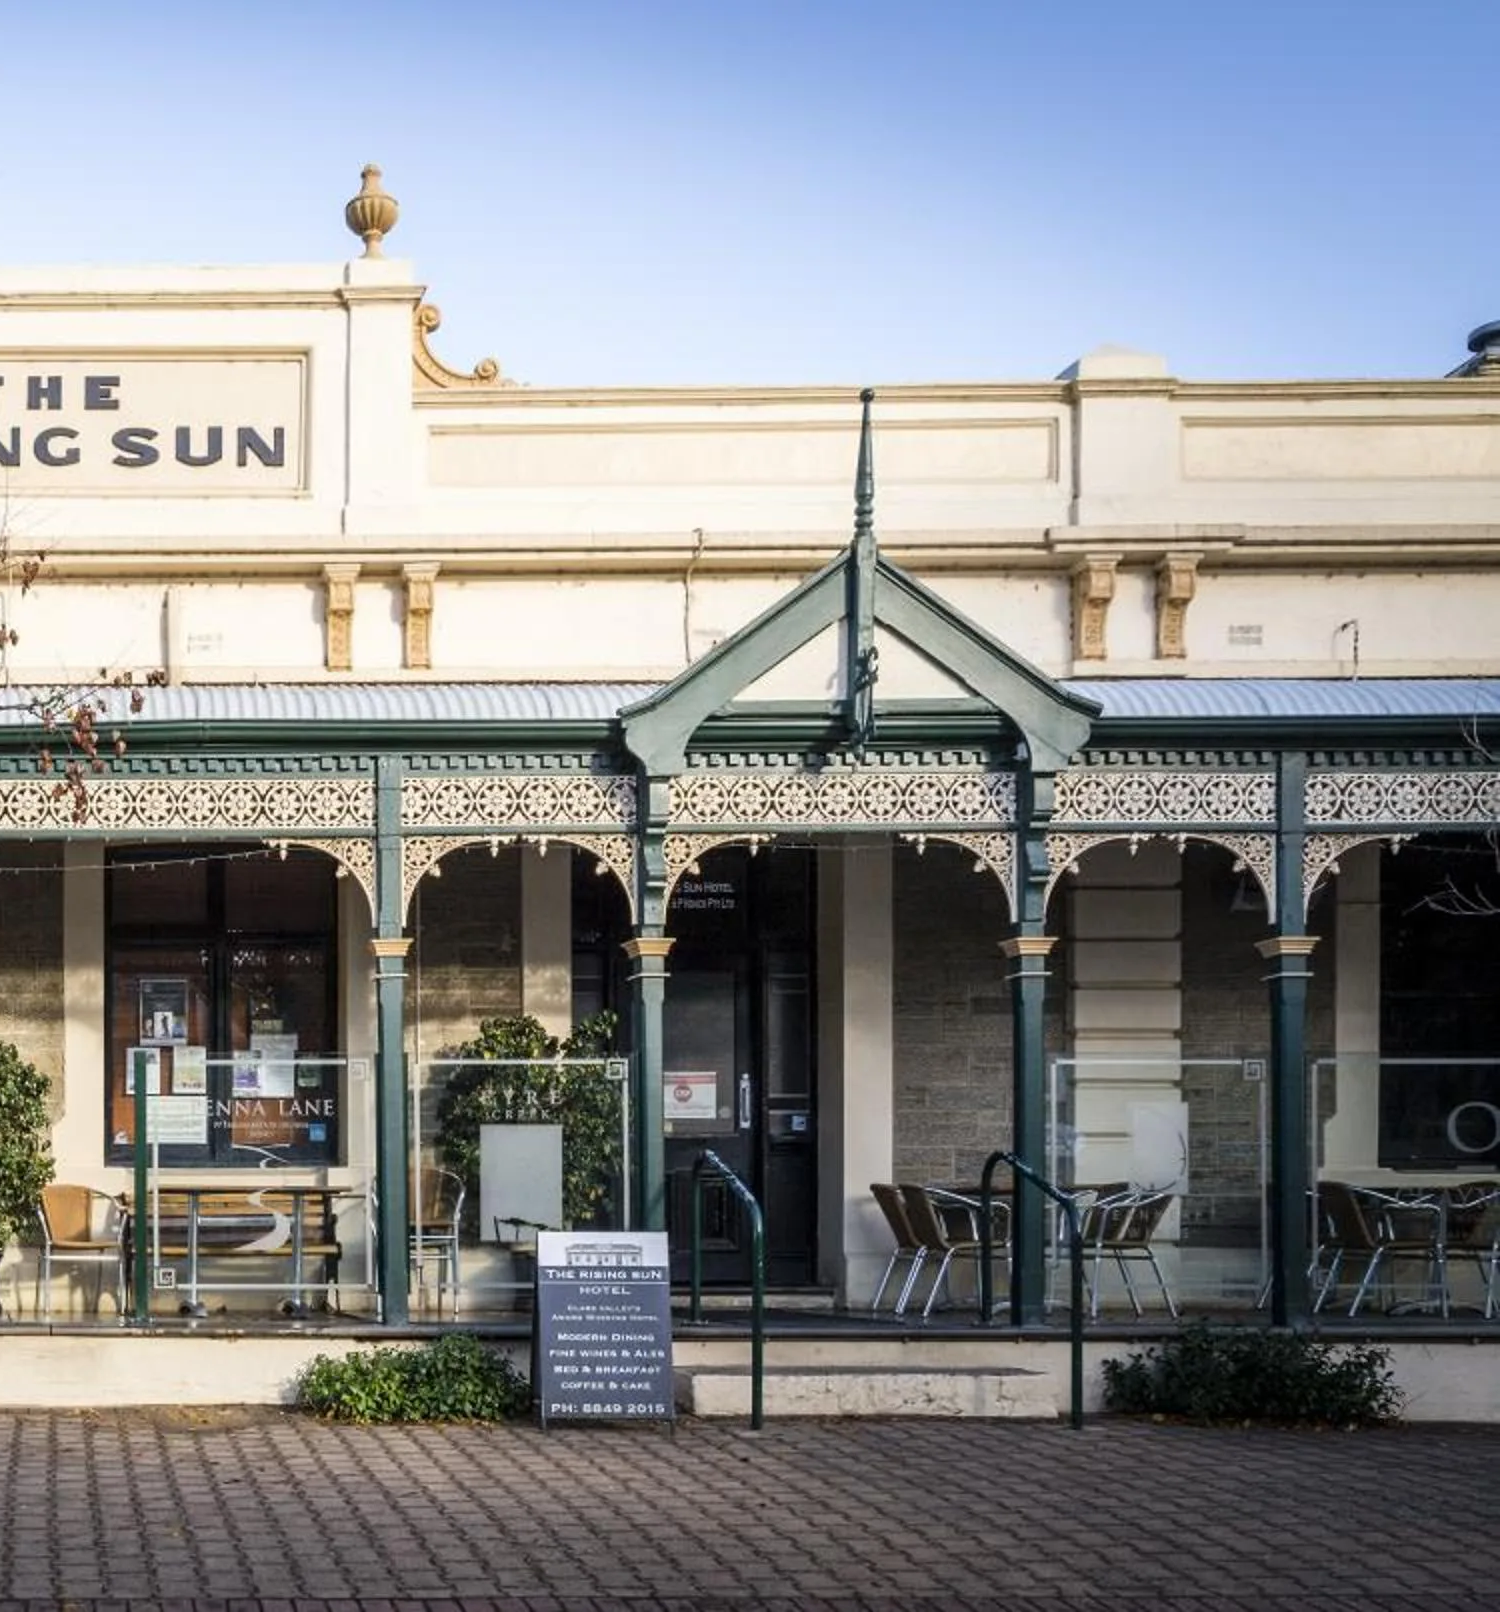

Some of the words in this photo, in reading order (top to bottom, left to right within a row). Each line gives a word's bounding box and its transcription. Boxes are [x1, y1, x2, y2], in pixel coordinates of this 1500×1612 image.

[110, 426, 285, 468] SUN
[192, 1099, 266, 1117] ENNA
[279, 1099, 335, 1117] LANE
[546, 1269, 575, 1279] THE
[579, 1269, 627, 1279] RISING
[631, 1269, 662, 1279] SUN
[579, 1286, 631, 1295] HOTEL
